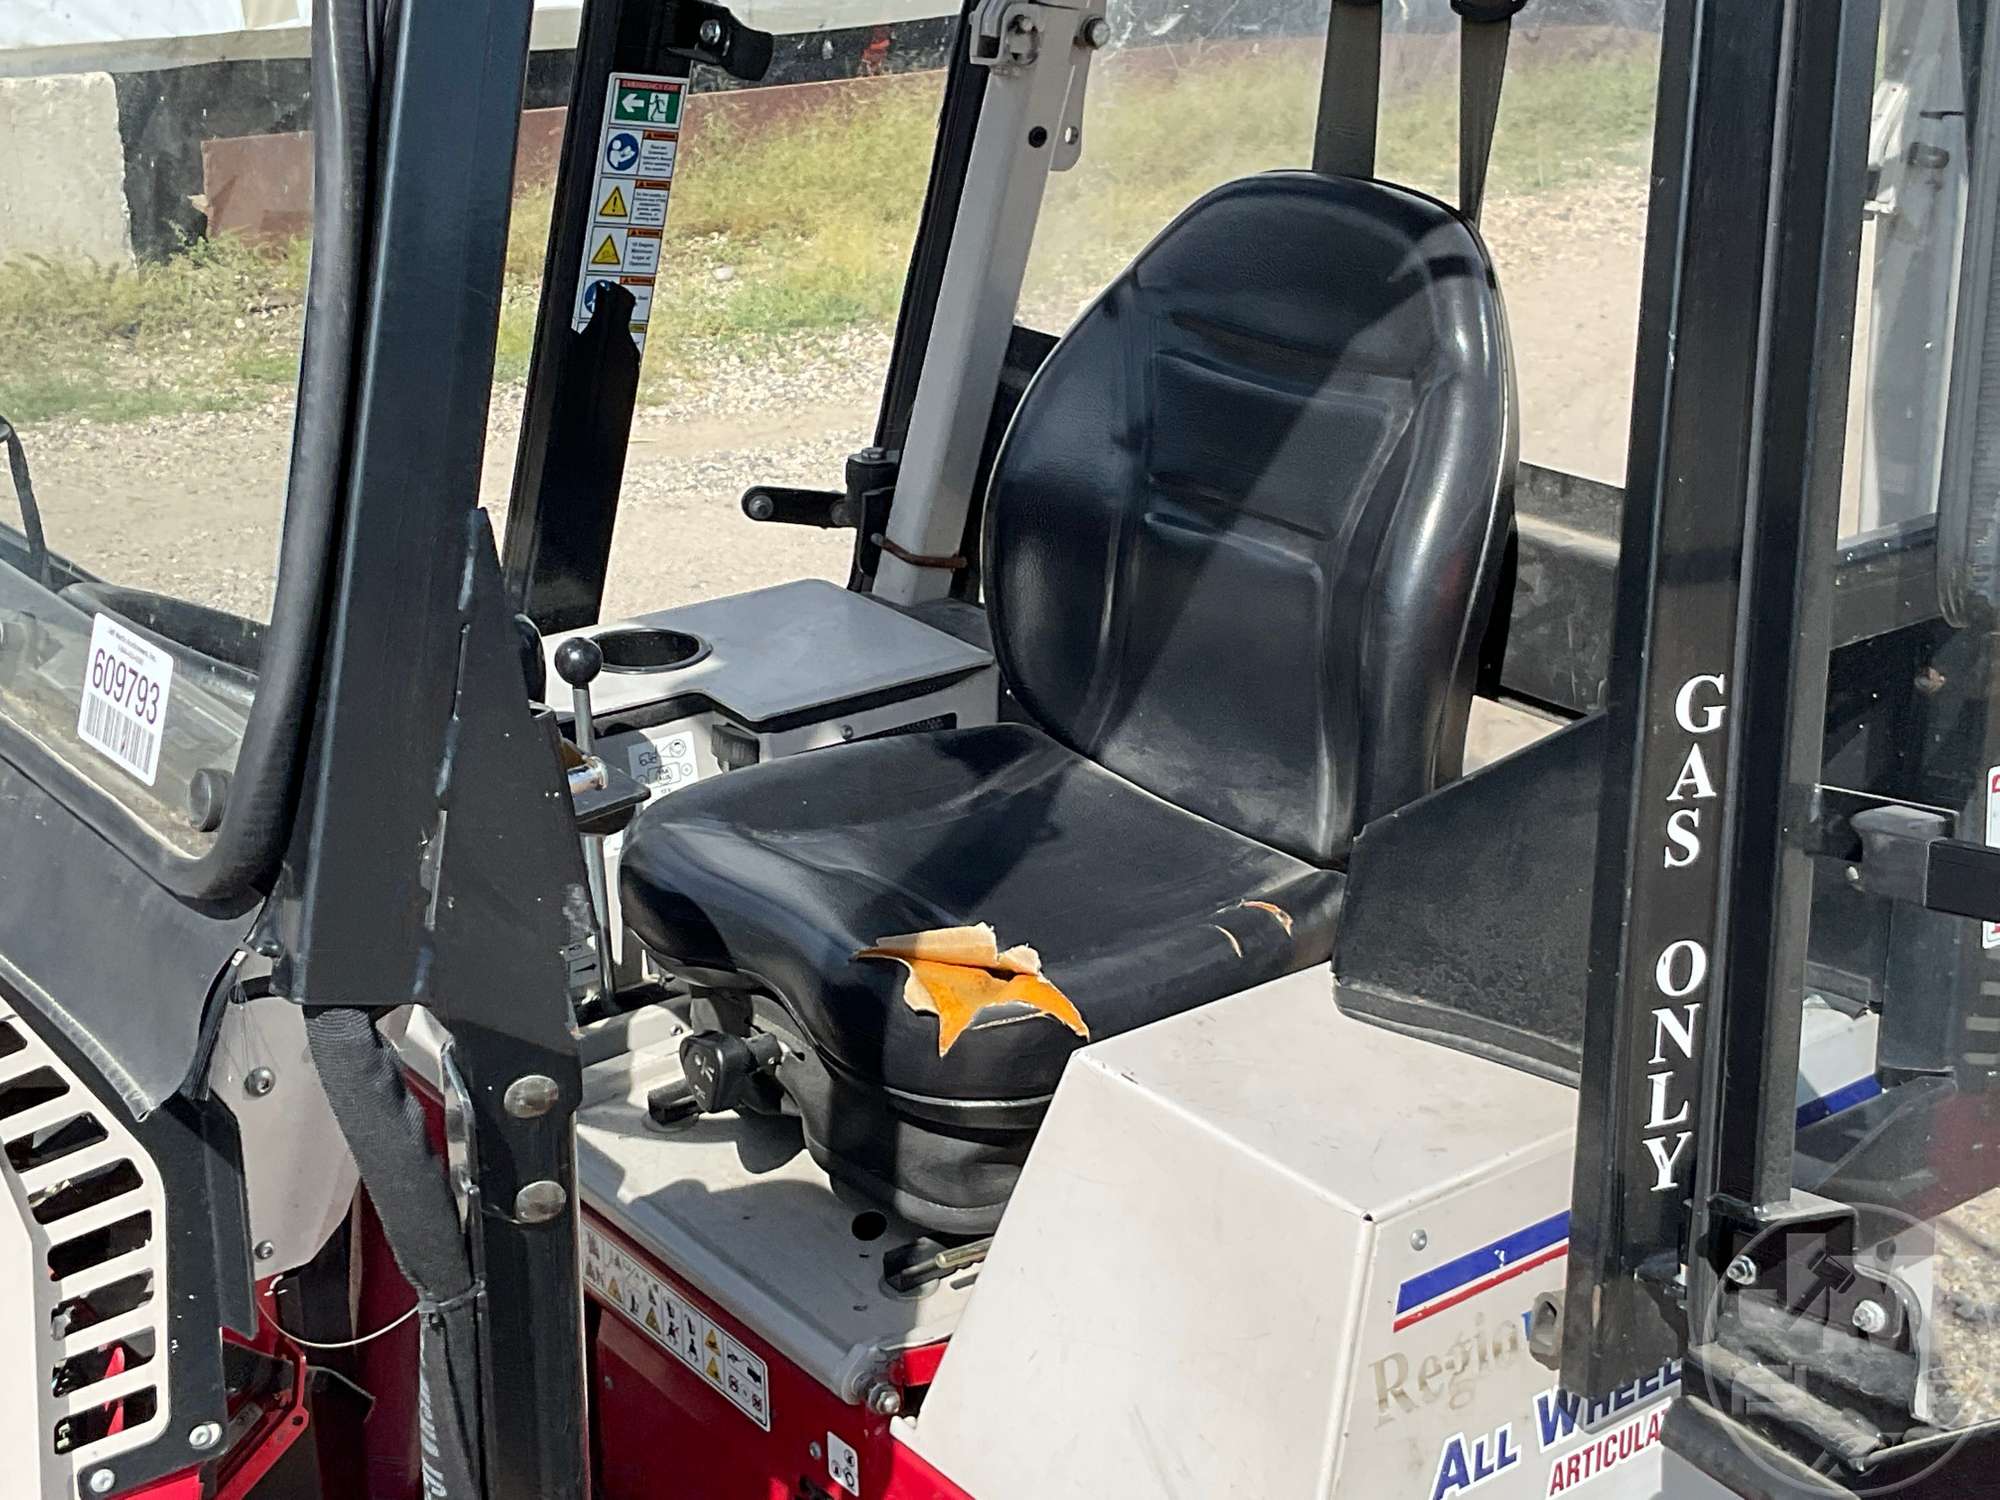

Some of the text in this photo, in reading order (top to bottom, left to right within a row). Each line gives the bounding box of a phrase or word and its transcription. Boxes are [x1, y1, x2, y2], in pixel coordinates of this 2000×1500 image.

[92, 647, 160, 725] 609793
[1642, 674, 1727, 1192] GAS ONLY
[1430, 1426, 1519, 1500] ALL
